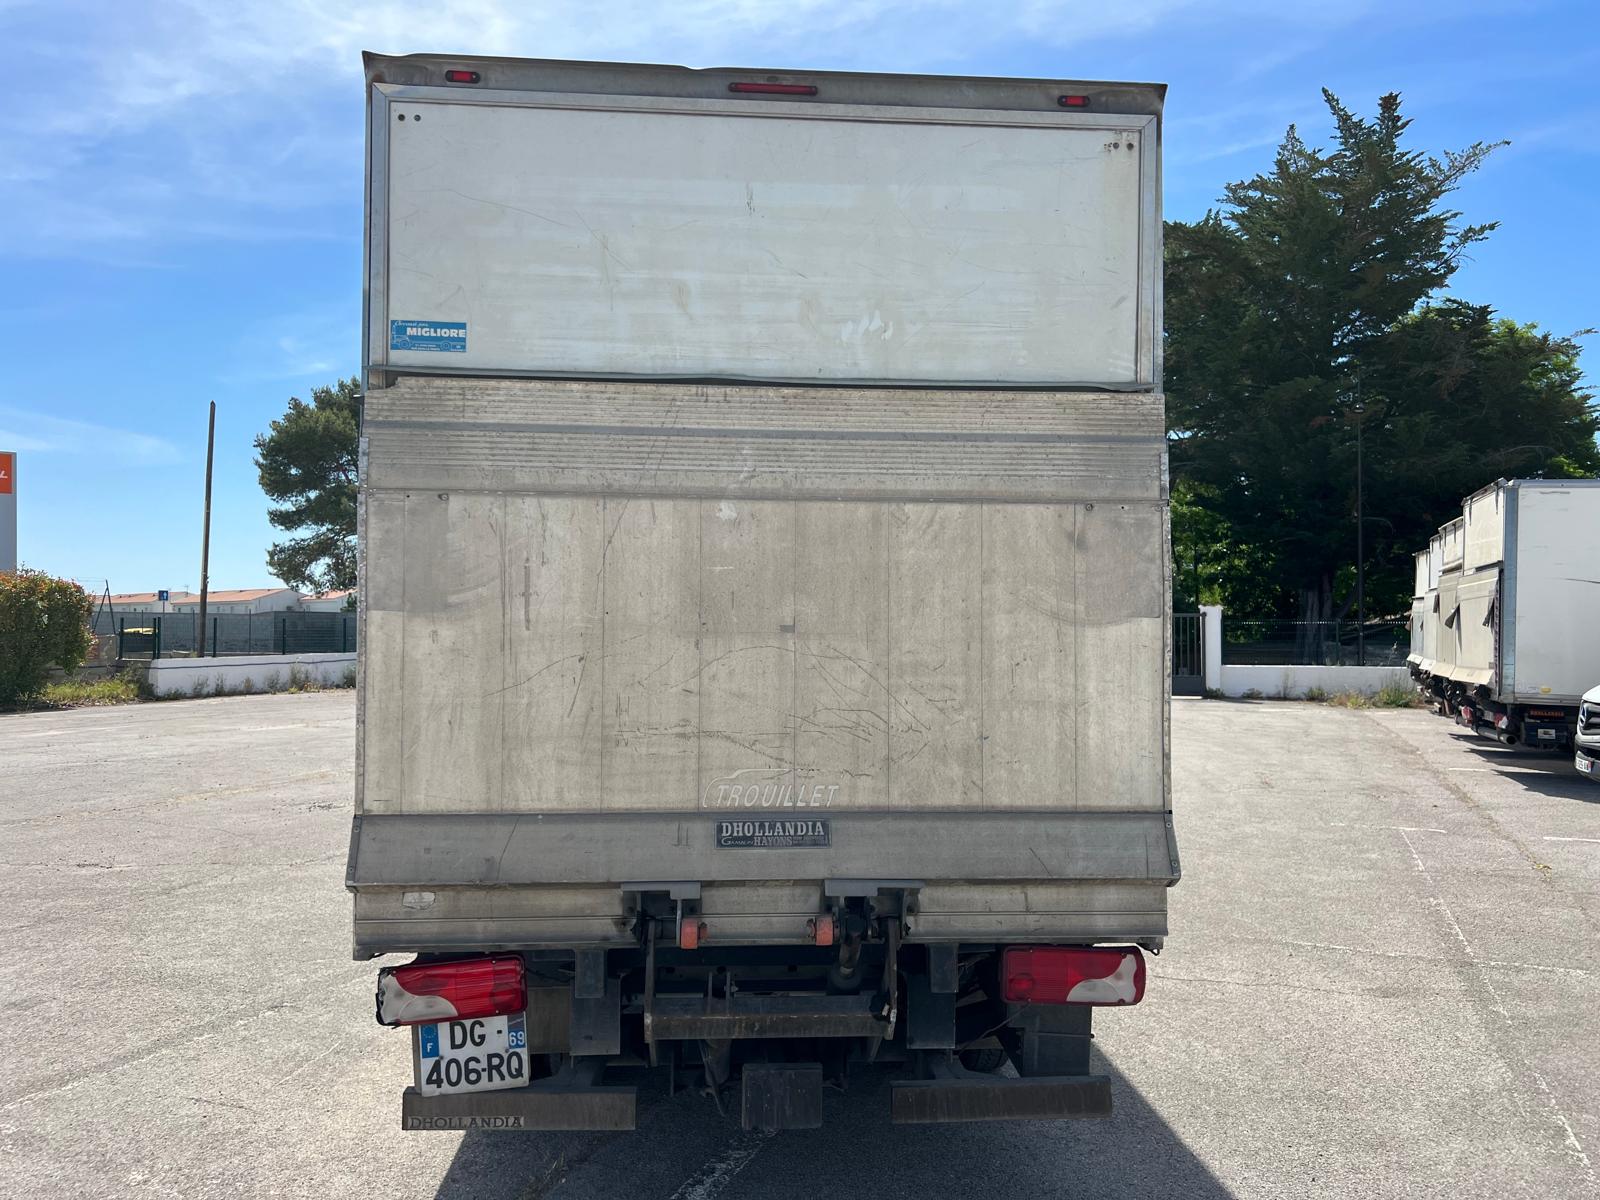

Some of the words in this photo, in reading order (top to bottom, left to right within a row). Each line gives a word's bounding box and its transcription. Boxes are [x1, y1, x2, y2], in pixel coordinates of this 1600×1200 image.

[406, 327, 466, 338] MIGLIORE
[717, 784, 840, 808] TROUILLET
[721, 821, 825, 837] DHOLLANDIA
[753, 836, 793, 846] HAYONS
[509, 1030, 525, 1046] 69
[426, 1042, 434, 1053] F
[425, 1051, 524, 1089] 406-RQ
[409, 1116, 523, 1129] DHOLLANDIA
